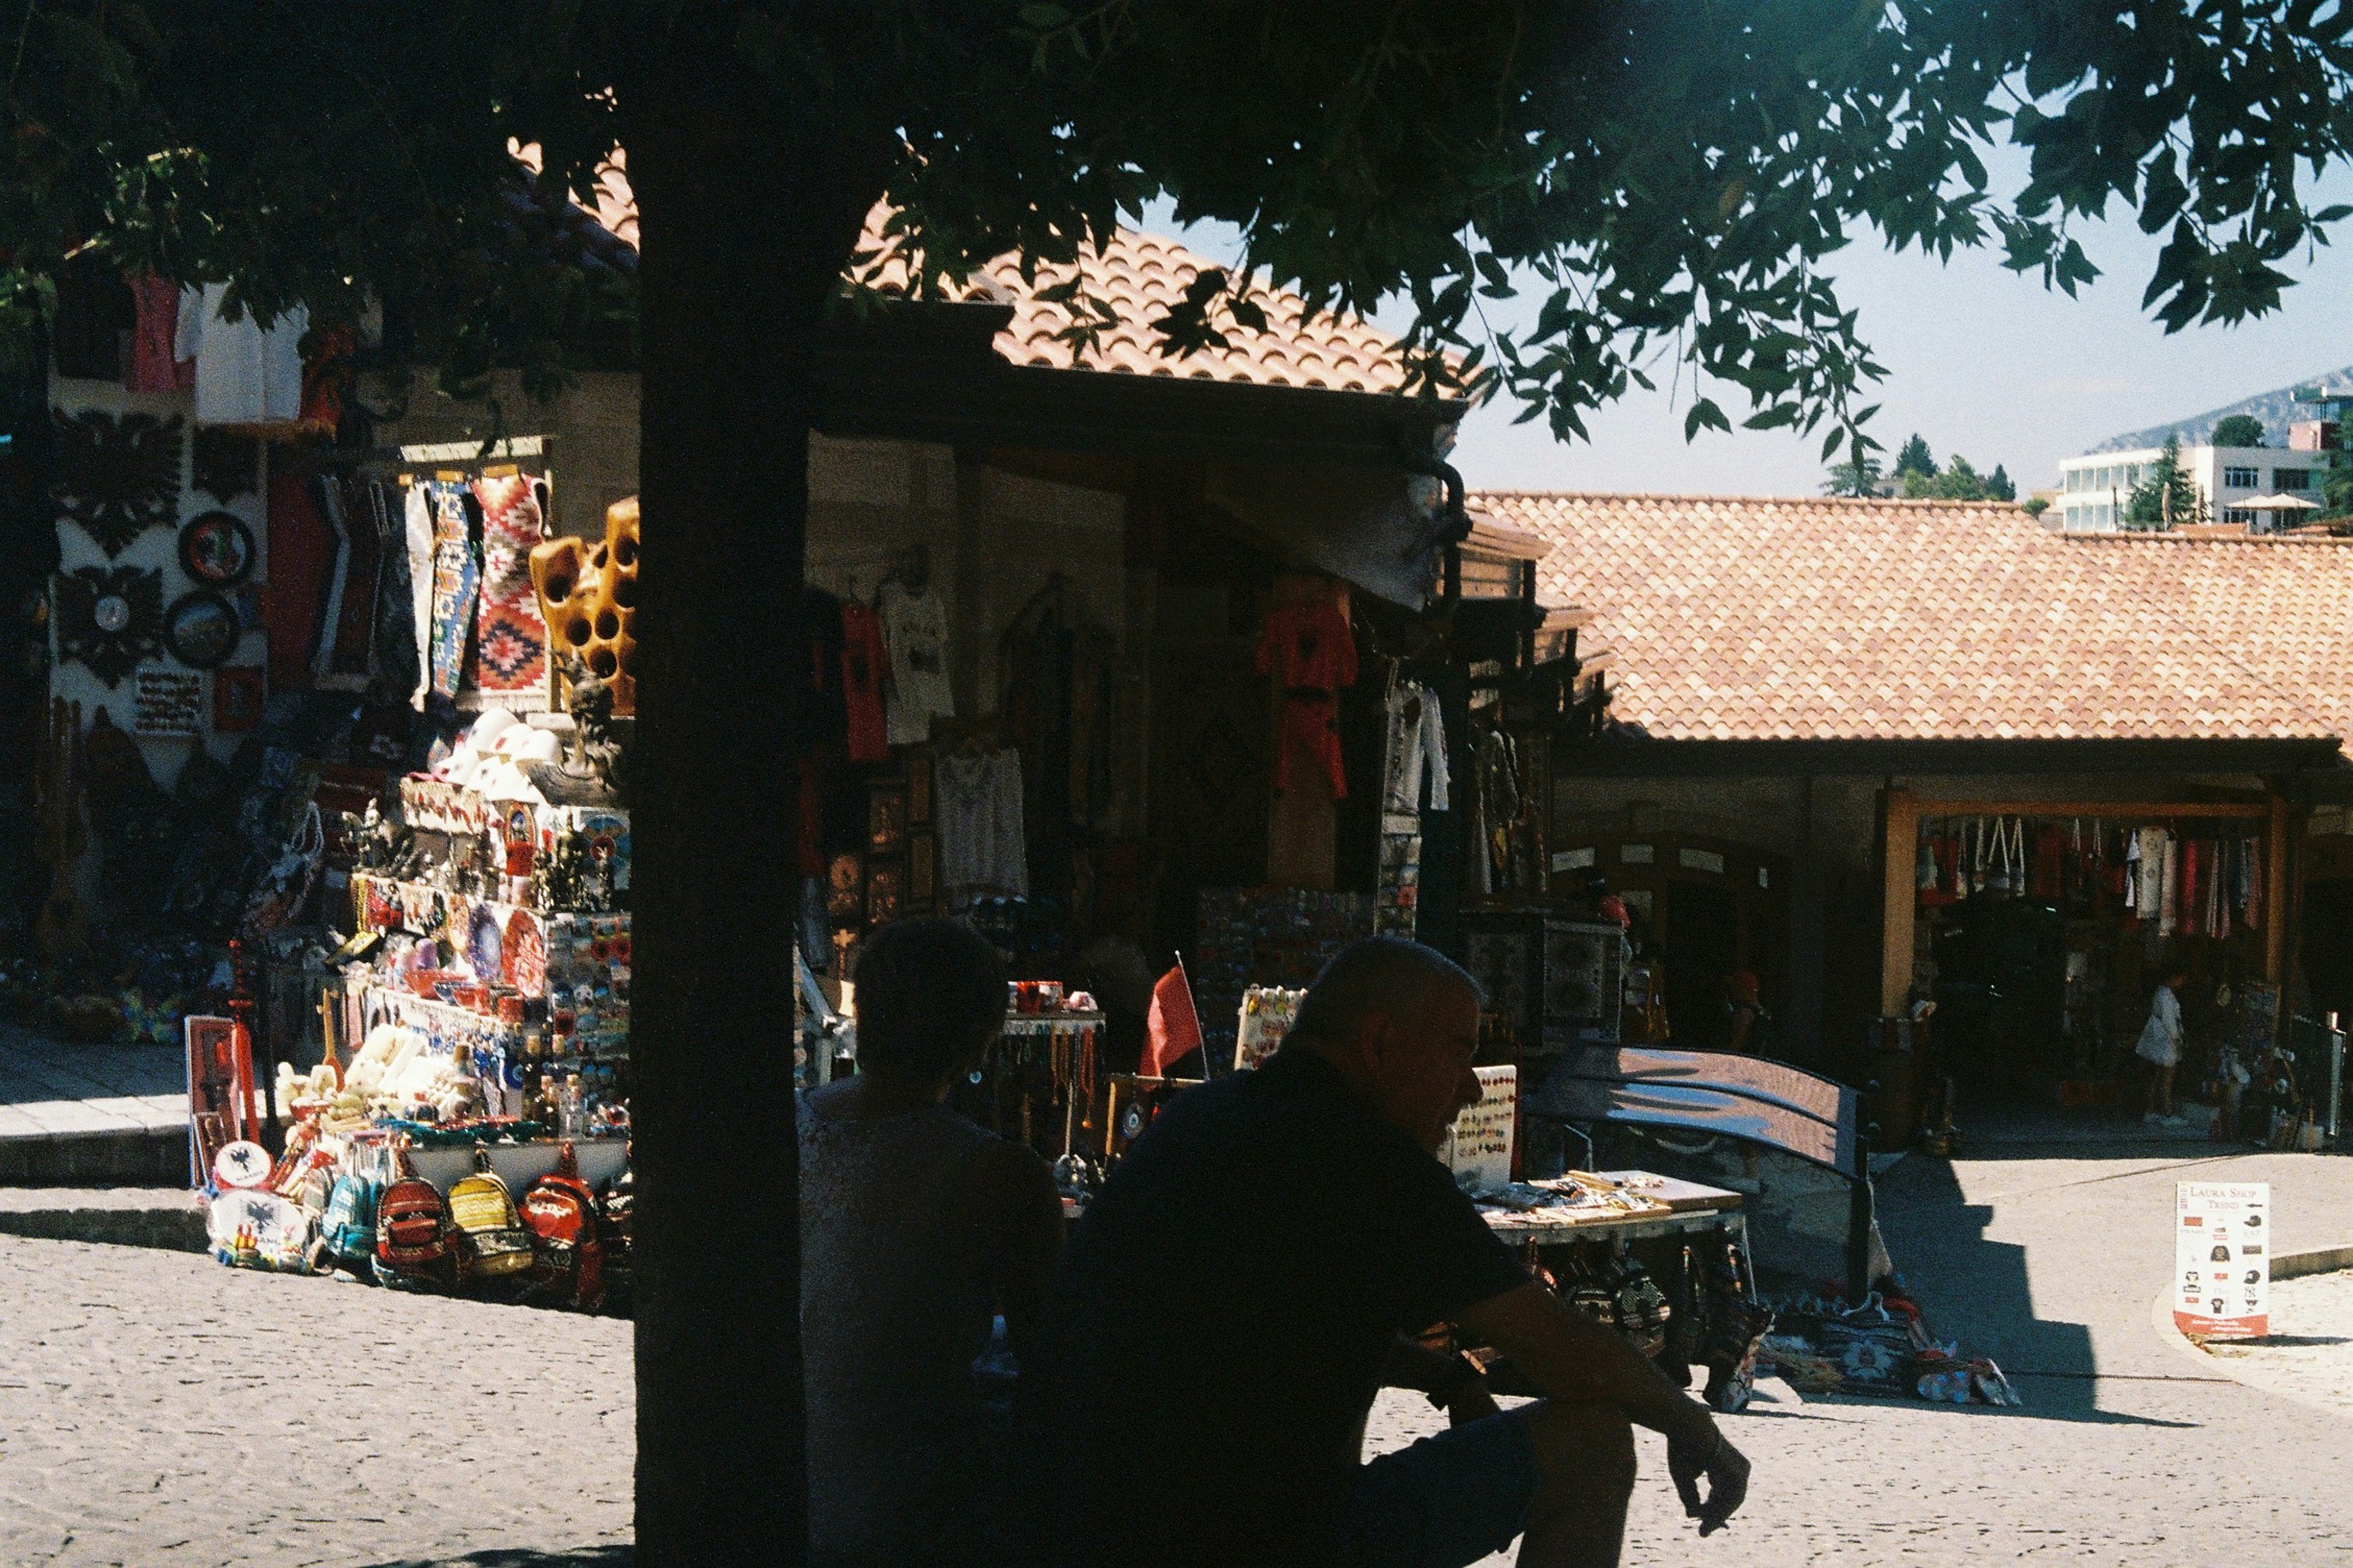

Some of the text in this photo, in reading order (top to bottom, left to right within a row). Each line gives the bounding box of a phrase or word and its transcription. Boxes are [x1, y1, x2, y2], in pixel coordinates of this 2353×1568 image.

[2190, 1187, 2257, 1198] LAURA SHOP
[2208, 1200, 2239, 1209] TREND
